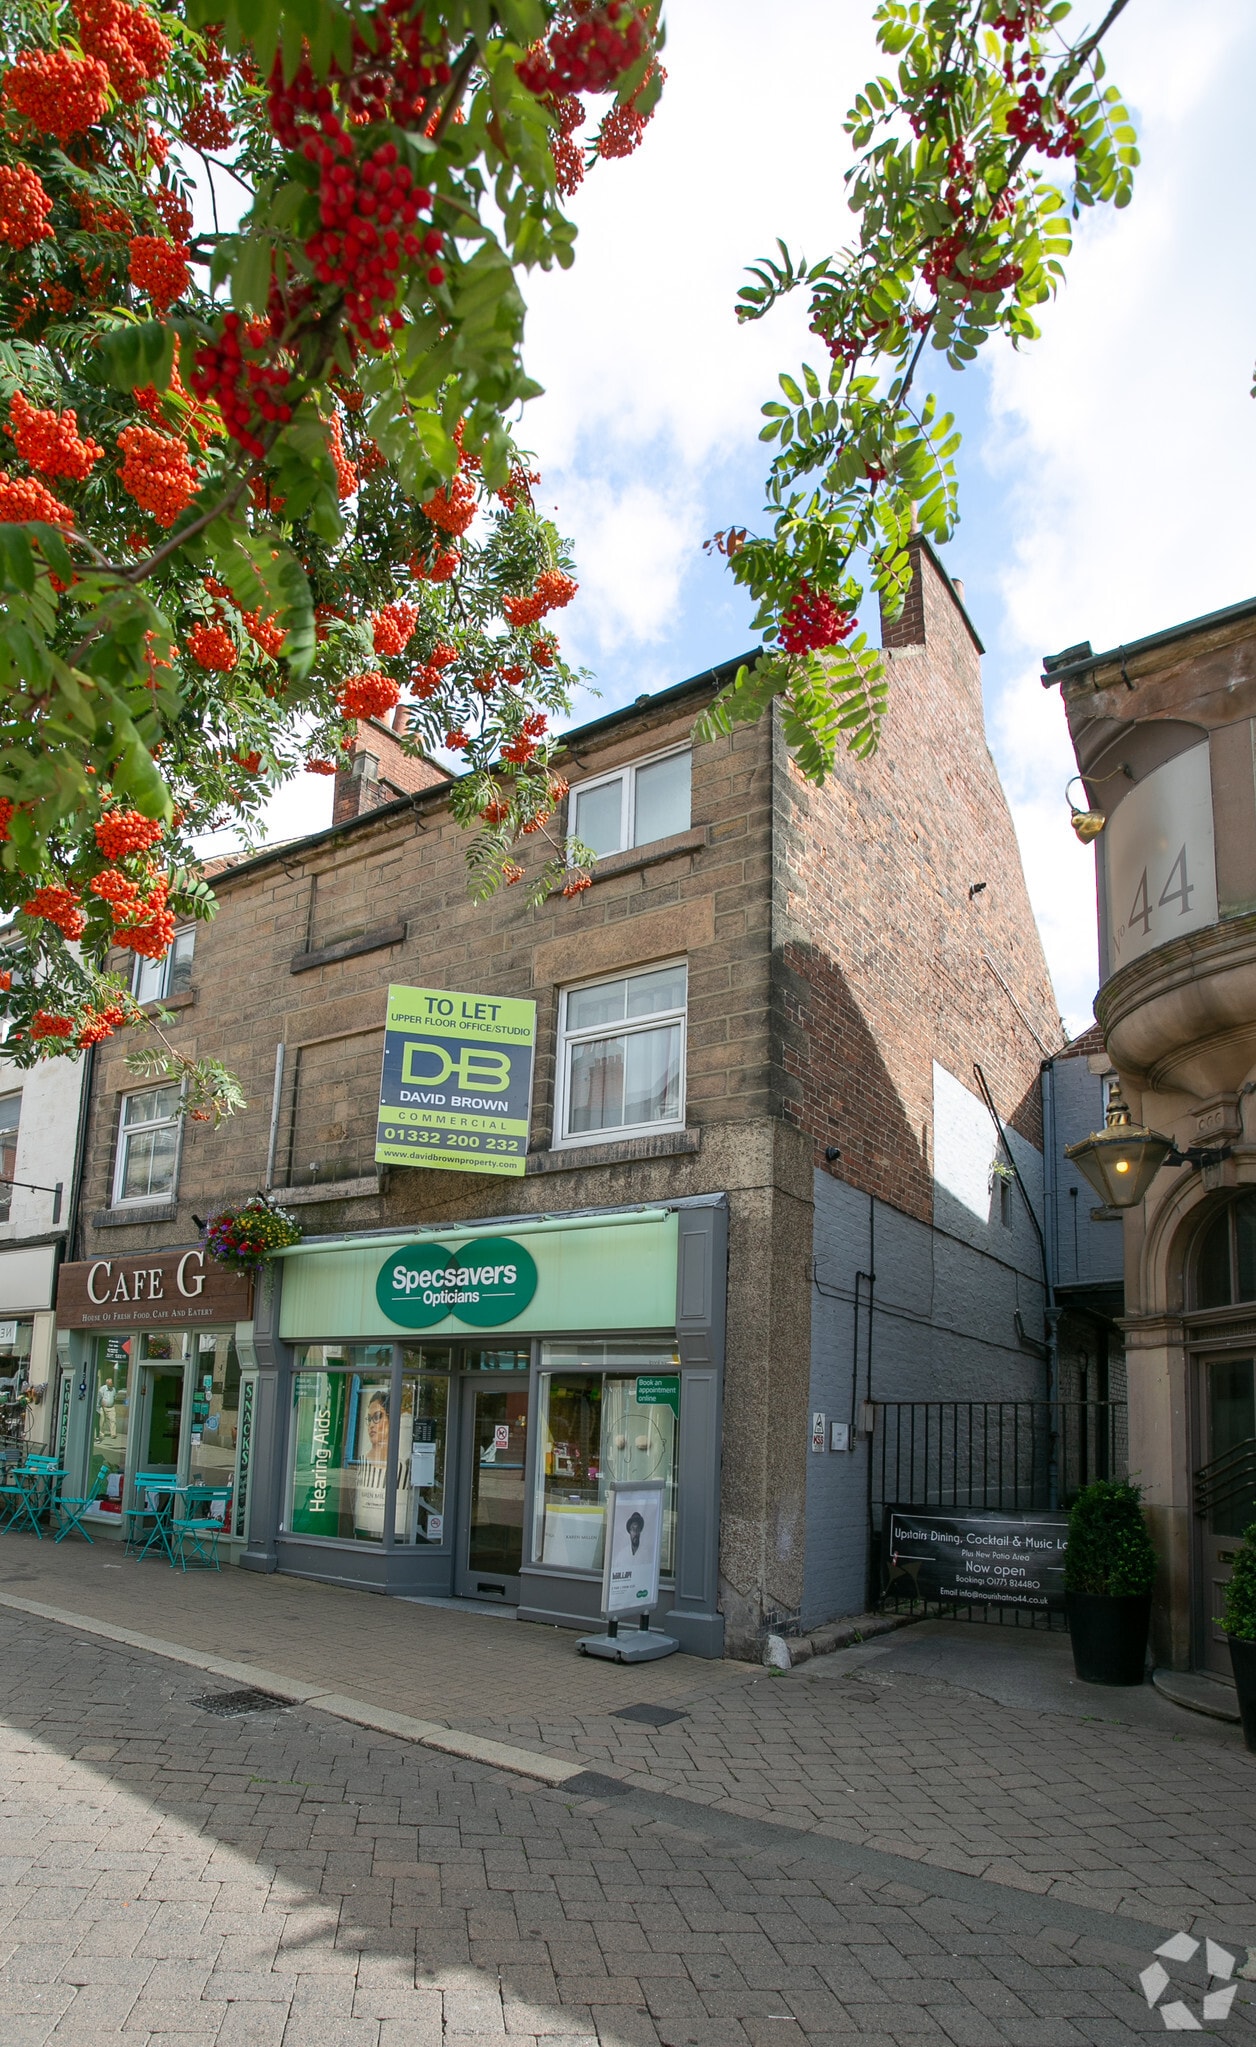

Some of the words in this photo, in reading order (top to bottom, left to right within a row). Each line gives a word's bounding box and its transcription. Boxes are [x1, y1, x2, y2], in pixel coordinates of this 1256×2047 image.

[1128, 842, 1194, 936] 44
[424, 996, 454, 1015] TO
[461, 1001, 502, 1021] LET
[391, 1013, 422, 1024] UPPER
[424, 1017, 457, 1028] FLOOR
[459, 1021, 531, 1036] OFFICE/STUDIO
[400, 1090, 446, 1105] DAVID
[451, 1095, 509, 1112] BROWN
[398, 1111, 507, 1130] COMMERCIAL
[384, 1127, 441, 1144] 01332
[446, 1133, 480, 1148] 200
[485, 1138, 519, 1152] 232
[383, 1149, 518, 1169] www.davidbrownproperty.com
[87, 1261, 164, 1305] CAFE
[176, 1250, 206, 1298] G
[392, 1265, 518, 1294] Specsavers
[422, 1289, 480, 1307] Opticians
[82, 1313, 101, 1322] HOUSE
[113, 1311, 132, 1320] FRESH
[152, 1309, 169, 1319] CAFE
[171, 1308, 186, 1317] AND
[188, 1307, 214, 1317] EATERY
[638, 1386, 677, 1395] appointment
[241, 1384, 253, 1465] SNACKS
[313, 1408, 331, 1445] Aids
[309, 1447, 332, 1513] Hearing
[894, 1527, 928, 1541] Upstairs
[930, 1530, 963, 1546] Dining,
[966, 1533, 1010, 1547] Cocktail
[1012, 1536, 1022, 1548] &
[1025, 1537, 1053, 1550] Music
[961, 1549, 974, 1558] Plus
[975, 1551, 990, 1559] New
[992, 1552, 1010, 1561] Patio
[1012, 1553, 1031, 1562] Area
[965, 1561, 990, 1574] Now
[993, 1564, 1026, 1577] open
[955, 1574, 985, 1586] Bookings
[986, 1577, 1008, 1587] 01773
[1009, 1579, 1041, 1589] 824480
[940, 1586, 958, 1597] Email
[959, 1588, 1049, 1605] info@nourishatno44.co.uk
